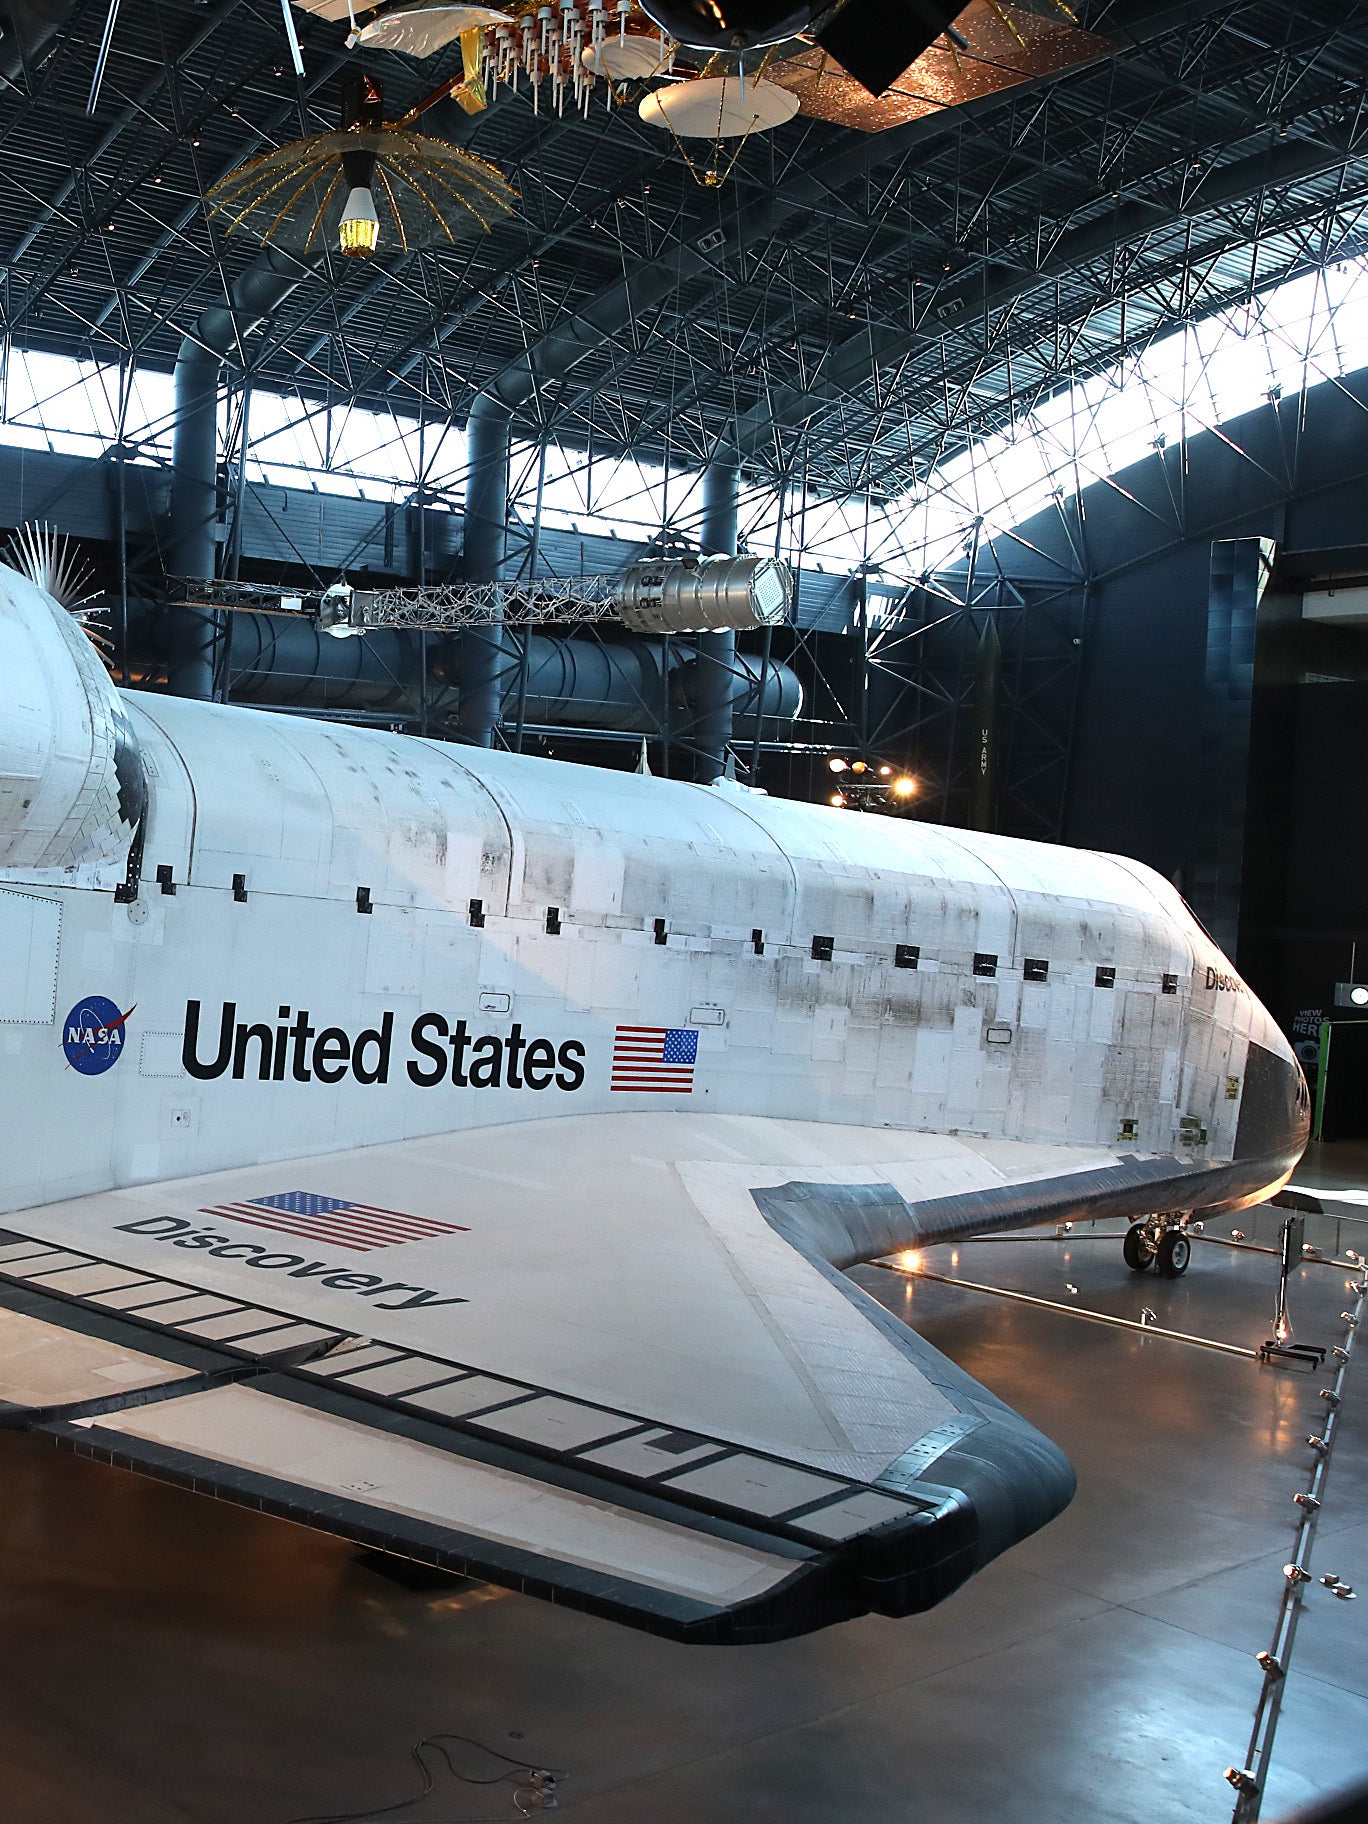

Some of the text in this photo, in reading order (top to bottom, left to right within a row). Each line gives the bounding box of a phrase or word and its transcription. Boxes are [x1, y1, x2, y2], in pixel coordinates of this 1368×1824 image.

[980, 728, 989, 776] US ARMY
[67, 1026, 122, 1045] NASA
[1299, 1009, 1323, 1017] VIEW
[181, 999, 586, 1092] United States
[112, 1215, 472, 1312] Discovery
